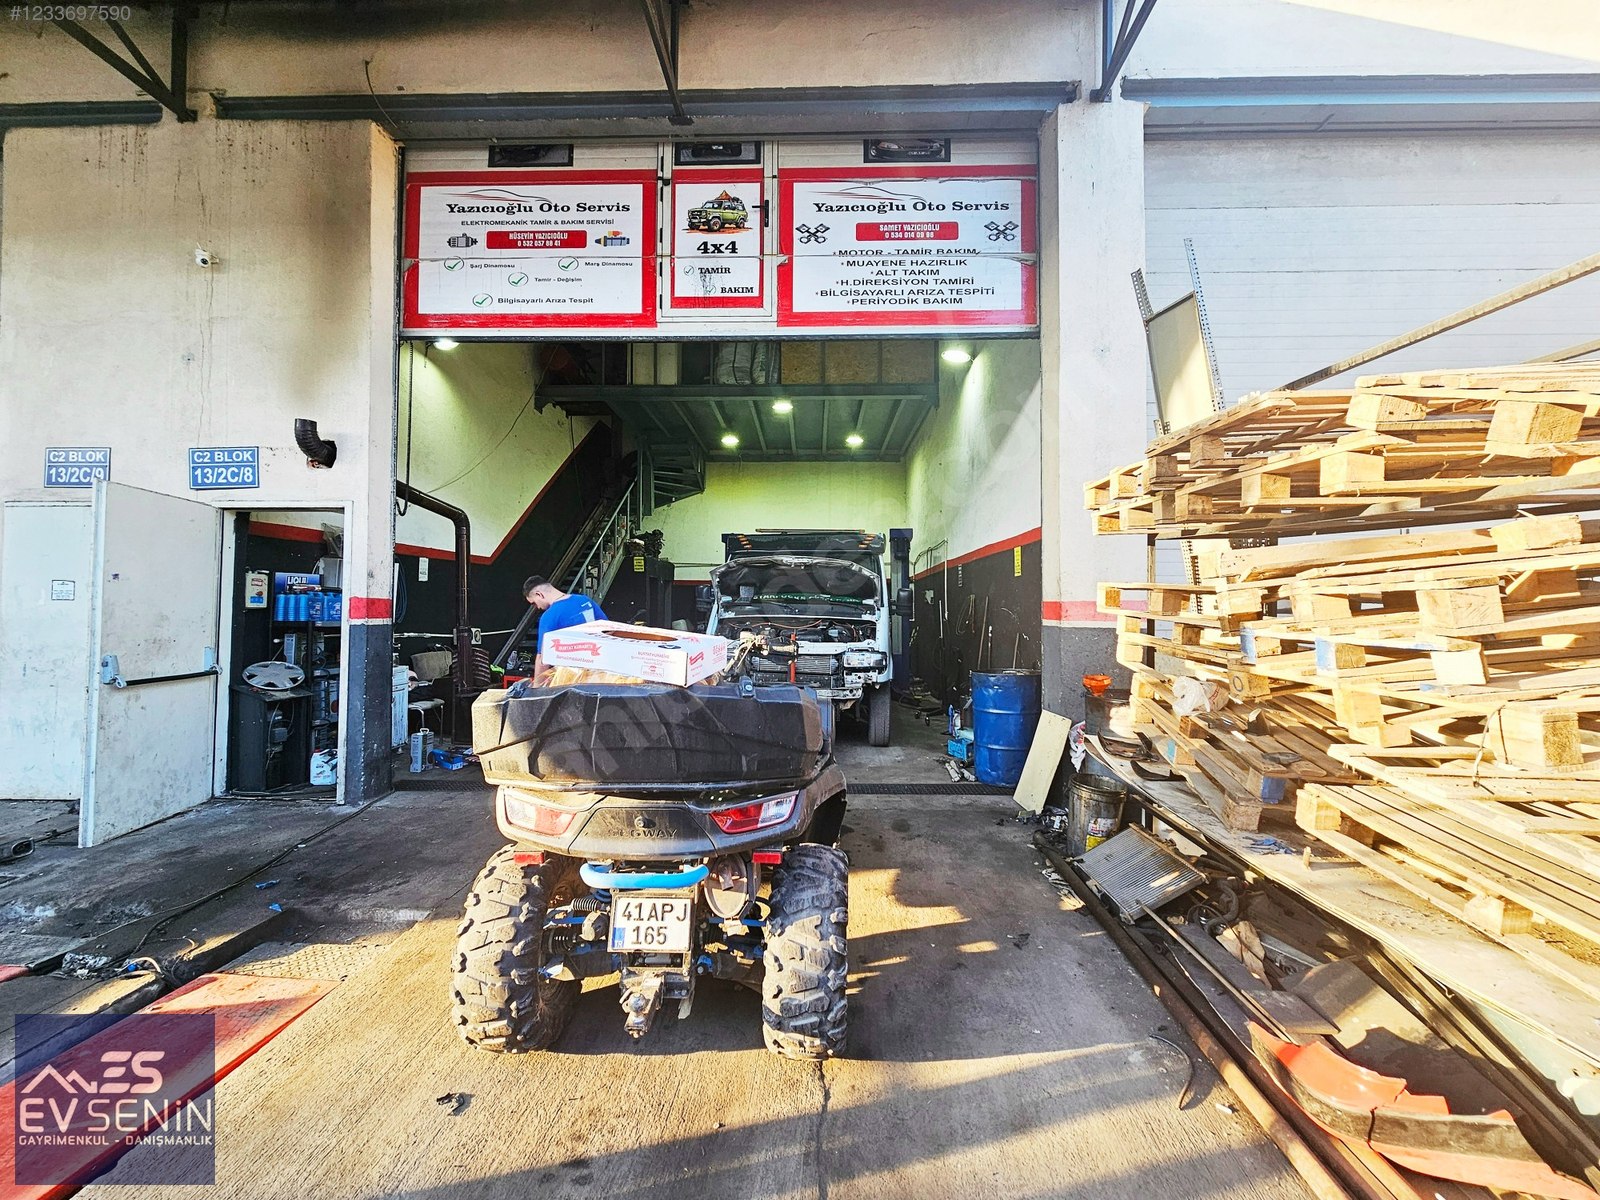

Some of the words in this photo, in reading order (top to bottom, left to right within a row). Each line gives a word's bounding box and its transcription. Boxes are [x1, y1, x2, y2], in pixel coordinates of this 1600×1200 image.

[446, 203, 534, 215] Yazıcıoğlu
[539, 202, 571, 213] Oto
[576, 202, 631, 213] Servis
[813, 202, 906, 214] Yazıcıoğlu
[912, 201, 946, 212] Oto
[952, 201, 1010, 211] Servis
[879, 224, 902, 232] SAMET
[696, 240, 738, 254] 4x4
[846, 259, 906, 267] MUAYENE
[910, 259, 967, 267] HAZIRLIK
[698, 265, 731, 274] TAMİR
[933, 276, 974, 285] TAMİRİ
[720, 286, 754, 294] BAKIM
[820, 287, 904, 297] BİLGİSAYARLI
[907, 288, 944, 296] ARIZA
[948, 287, 995, 295] TESPİTİ
[497, 297, 544, 305] Bilgisayarlı
[568, 297, 594, 305] Tespit
[851, 296, 919, 305] PERİYODİK
[49, 450, 66, 462] C2
[69, 450, 105, 462] BLOK
[194, 451, 211, 463] C2
[214, 450, 253, 462] BLOK
[49, 466, 104, 484] 13/2C/9
[194, 466, 254, 484] 13/2C/8
[631, 926, 668, 945] 165
